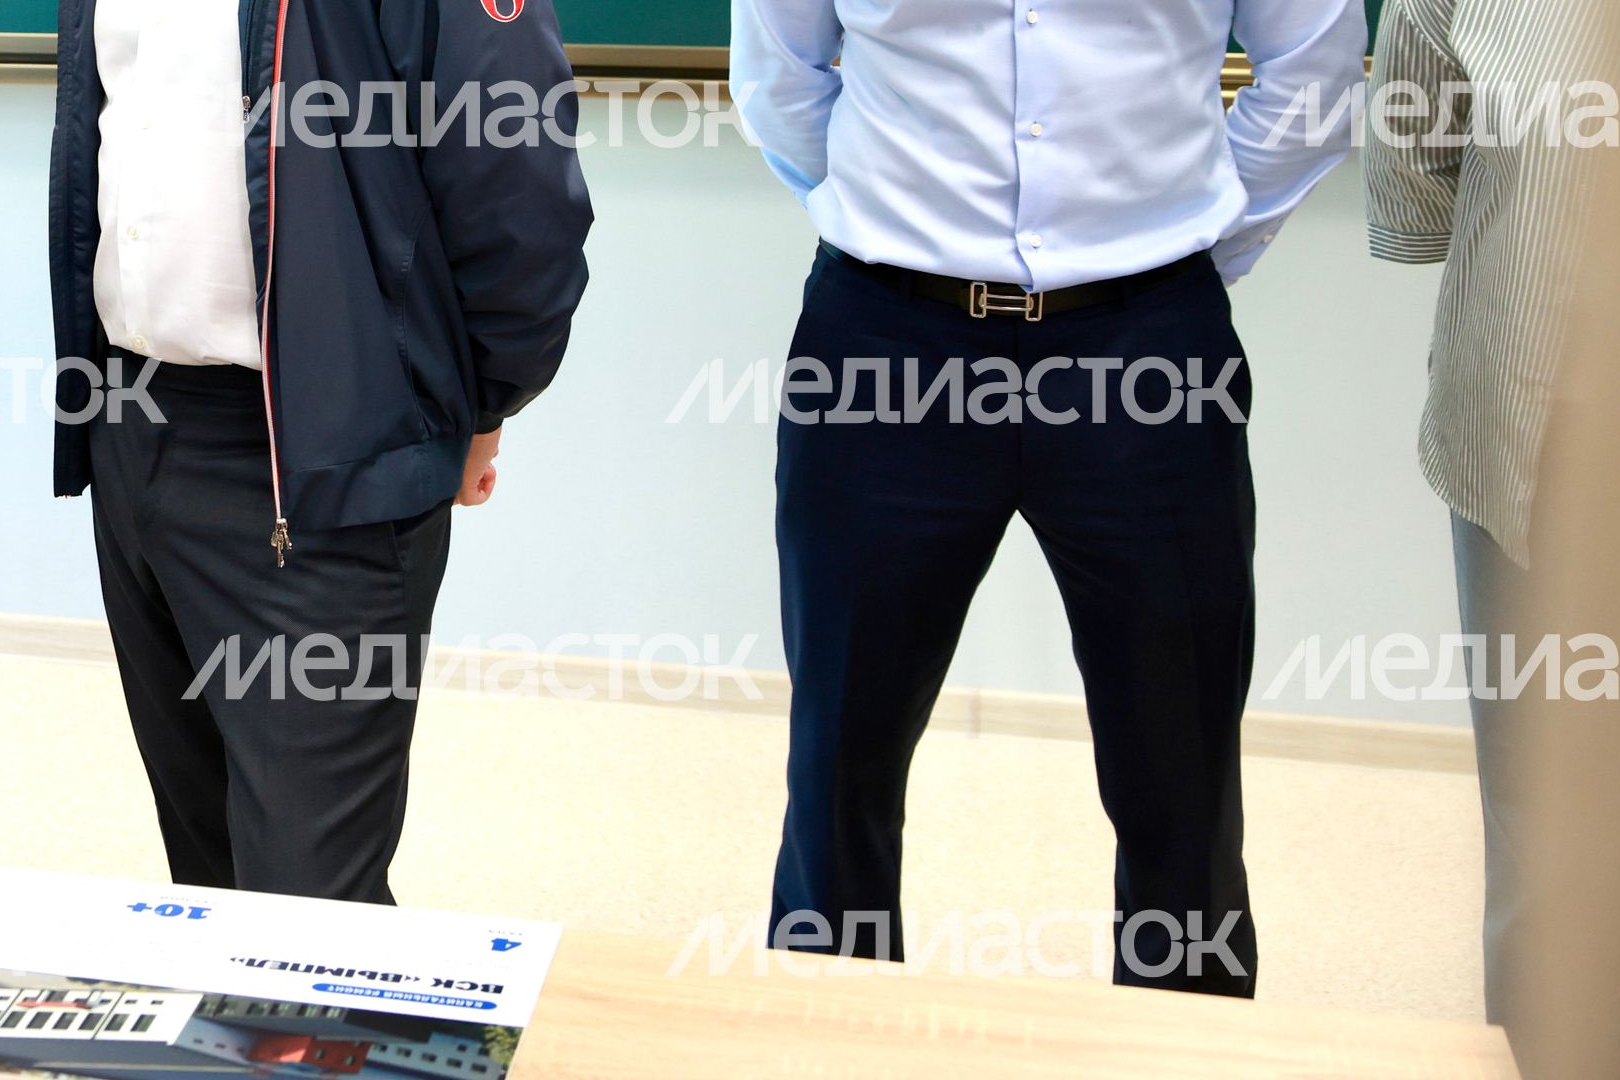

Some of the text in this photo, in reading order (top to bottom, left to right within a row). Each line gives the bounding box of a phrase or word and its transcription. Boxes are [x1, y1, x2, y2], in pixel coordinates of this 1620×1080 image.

[126, 901, 213, 920] 10+
[490, 937, 523, 952] 4
[432, 976, 504, 995] ВСК
